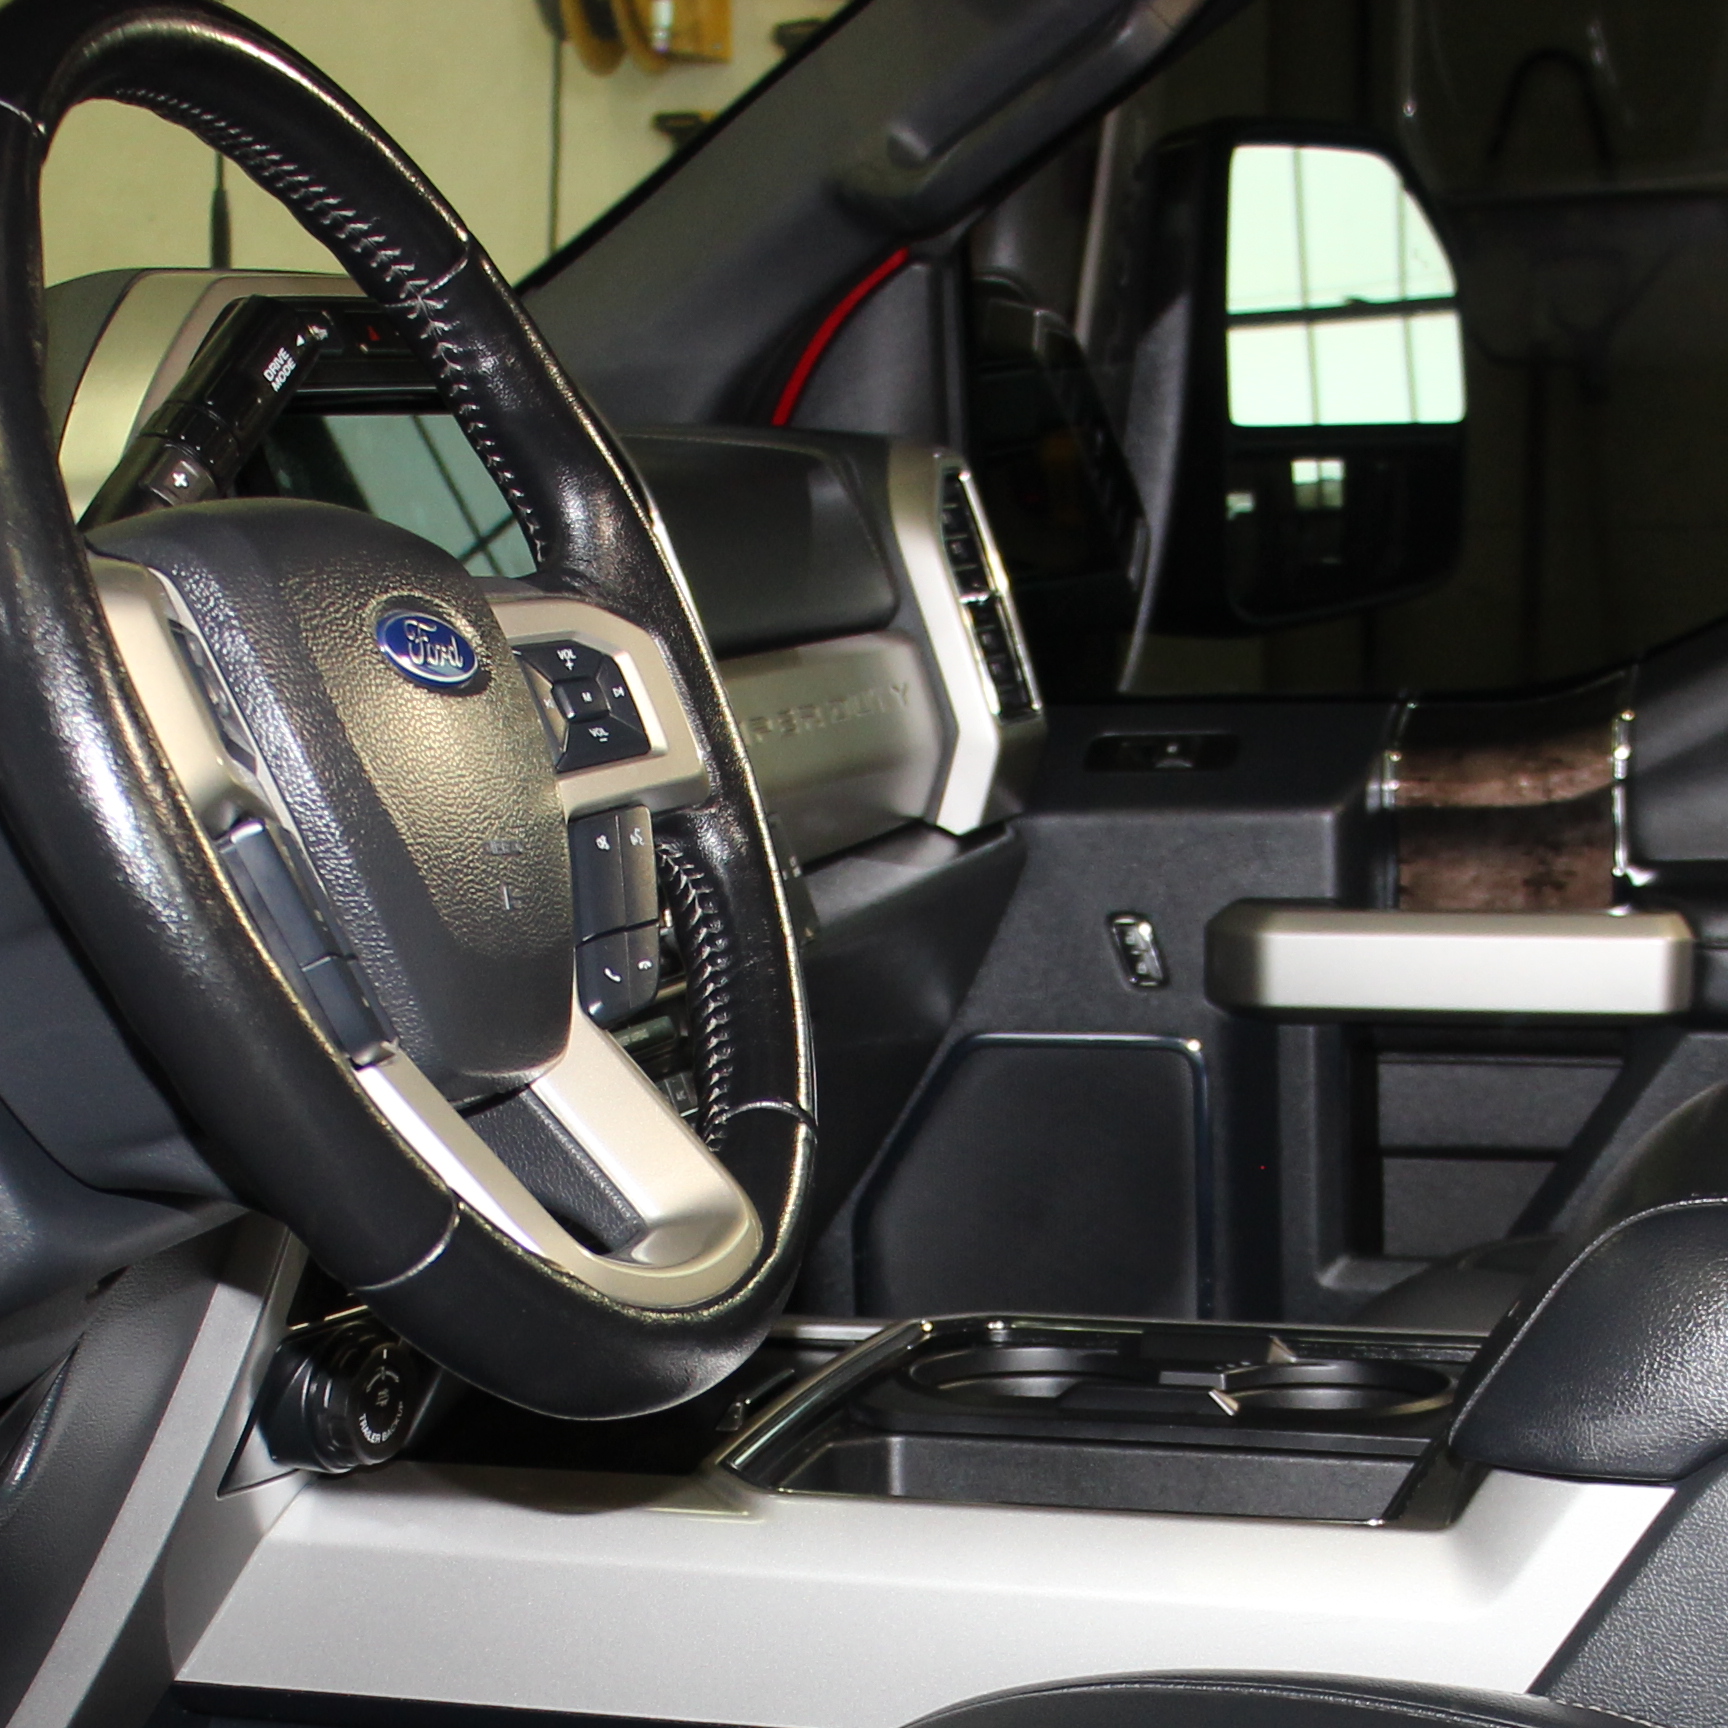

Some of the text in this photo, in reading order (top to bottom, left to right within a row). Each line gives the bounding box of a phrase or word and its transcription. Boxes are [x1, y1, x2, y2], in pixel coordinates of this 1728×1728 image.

[263, 347, 290, 382] DRIVE
[271, 357, 297, 393] MODE
[403, 619, 464, 669] Ford
[556, 648, 577, 661] VOL
[581, 691, 593, 703] M
[588, 726, 610, 738] VOL
[359, 1413, 381, 1444] TRAILER
